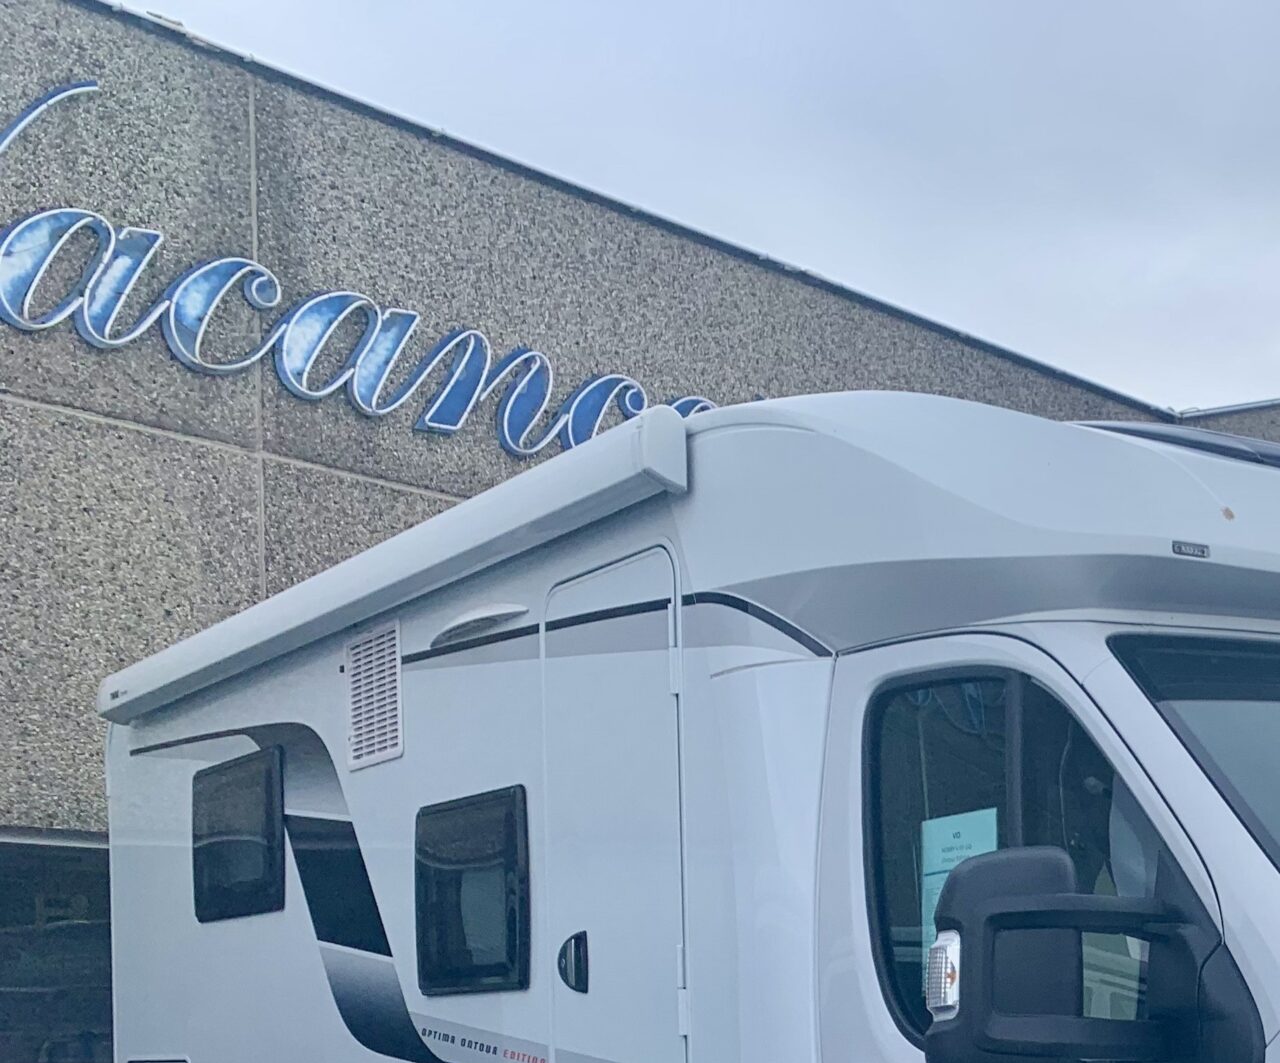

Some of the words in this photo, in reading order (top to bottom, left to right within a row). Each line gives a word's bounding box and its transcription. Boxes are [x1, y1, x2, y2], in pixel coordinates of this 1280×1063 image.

[0, 80, 718, 458] acanc
[421, 1027, 456, 1045] OPTIMA
[460, 1038, 498, 1056] ONTOUR
